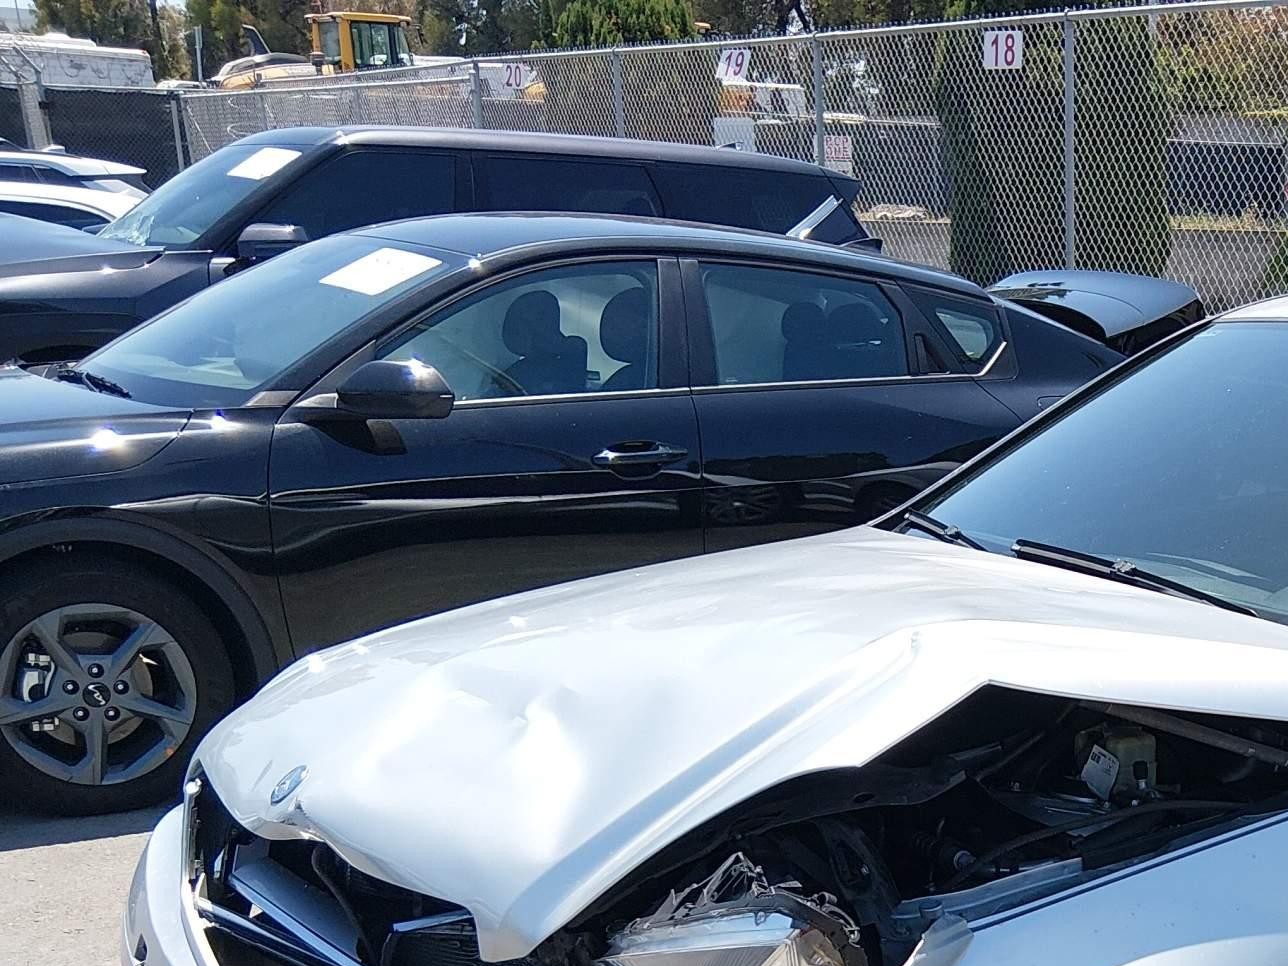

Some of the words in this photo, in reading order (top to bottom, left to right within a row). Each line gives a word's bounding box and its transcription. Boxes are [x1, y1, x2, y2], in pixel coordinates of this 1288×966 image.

[724, 50, 745, 77] 19
[991, 33, 1016, 67] 18
[505, 65, 522, 87] 20
